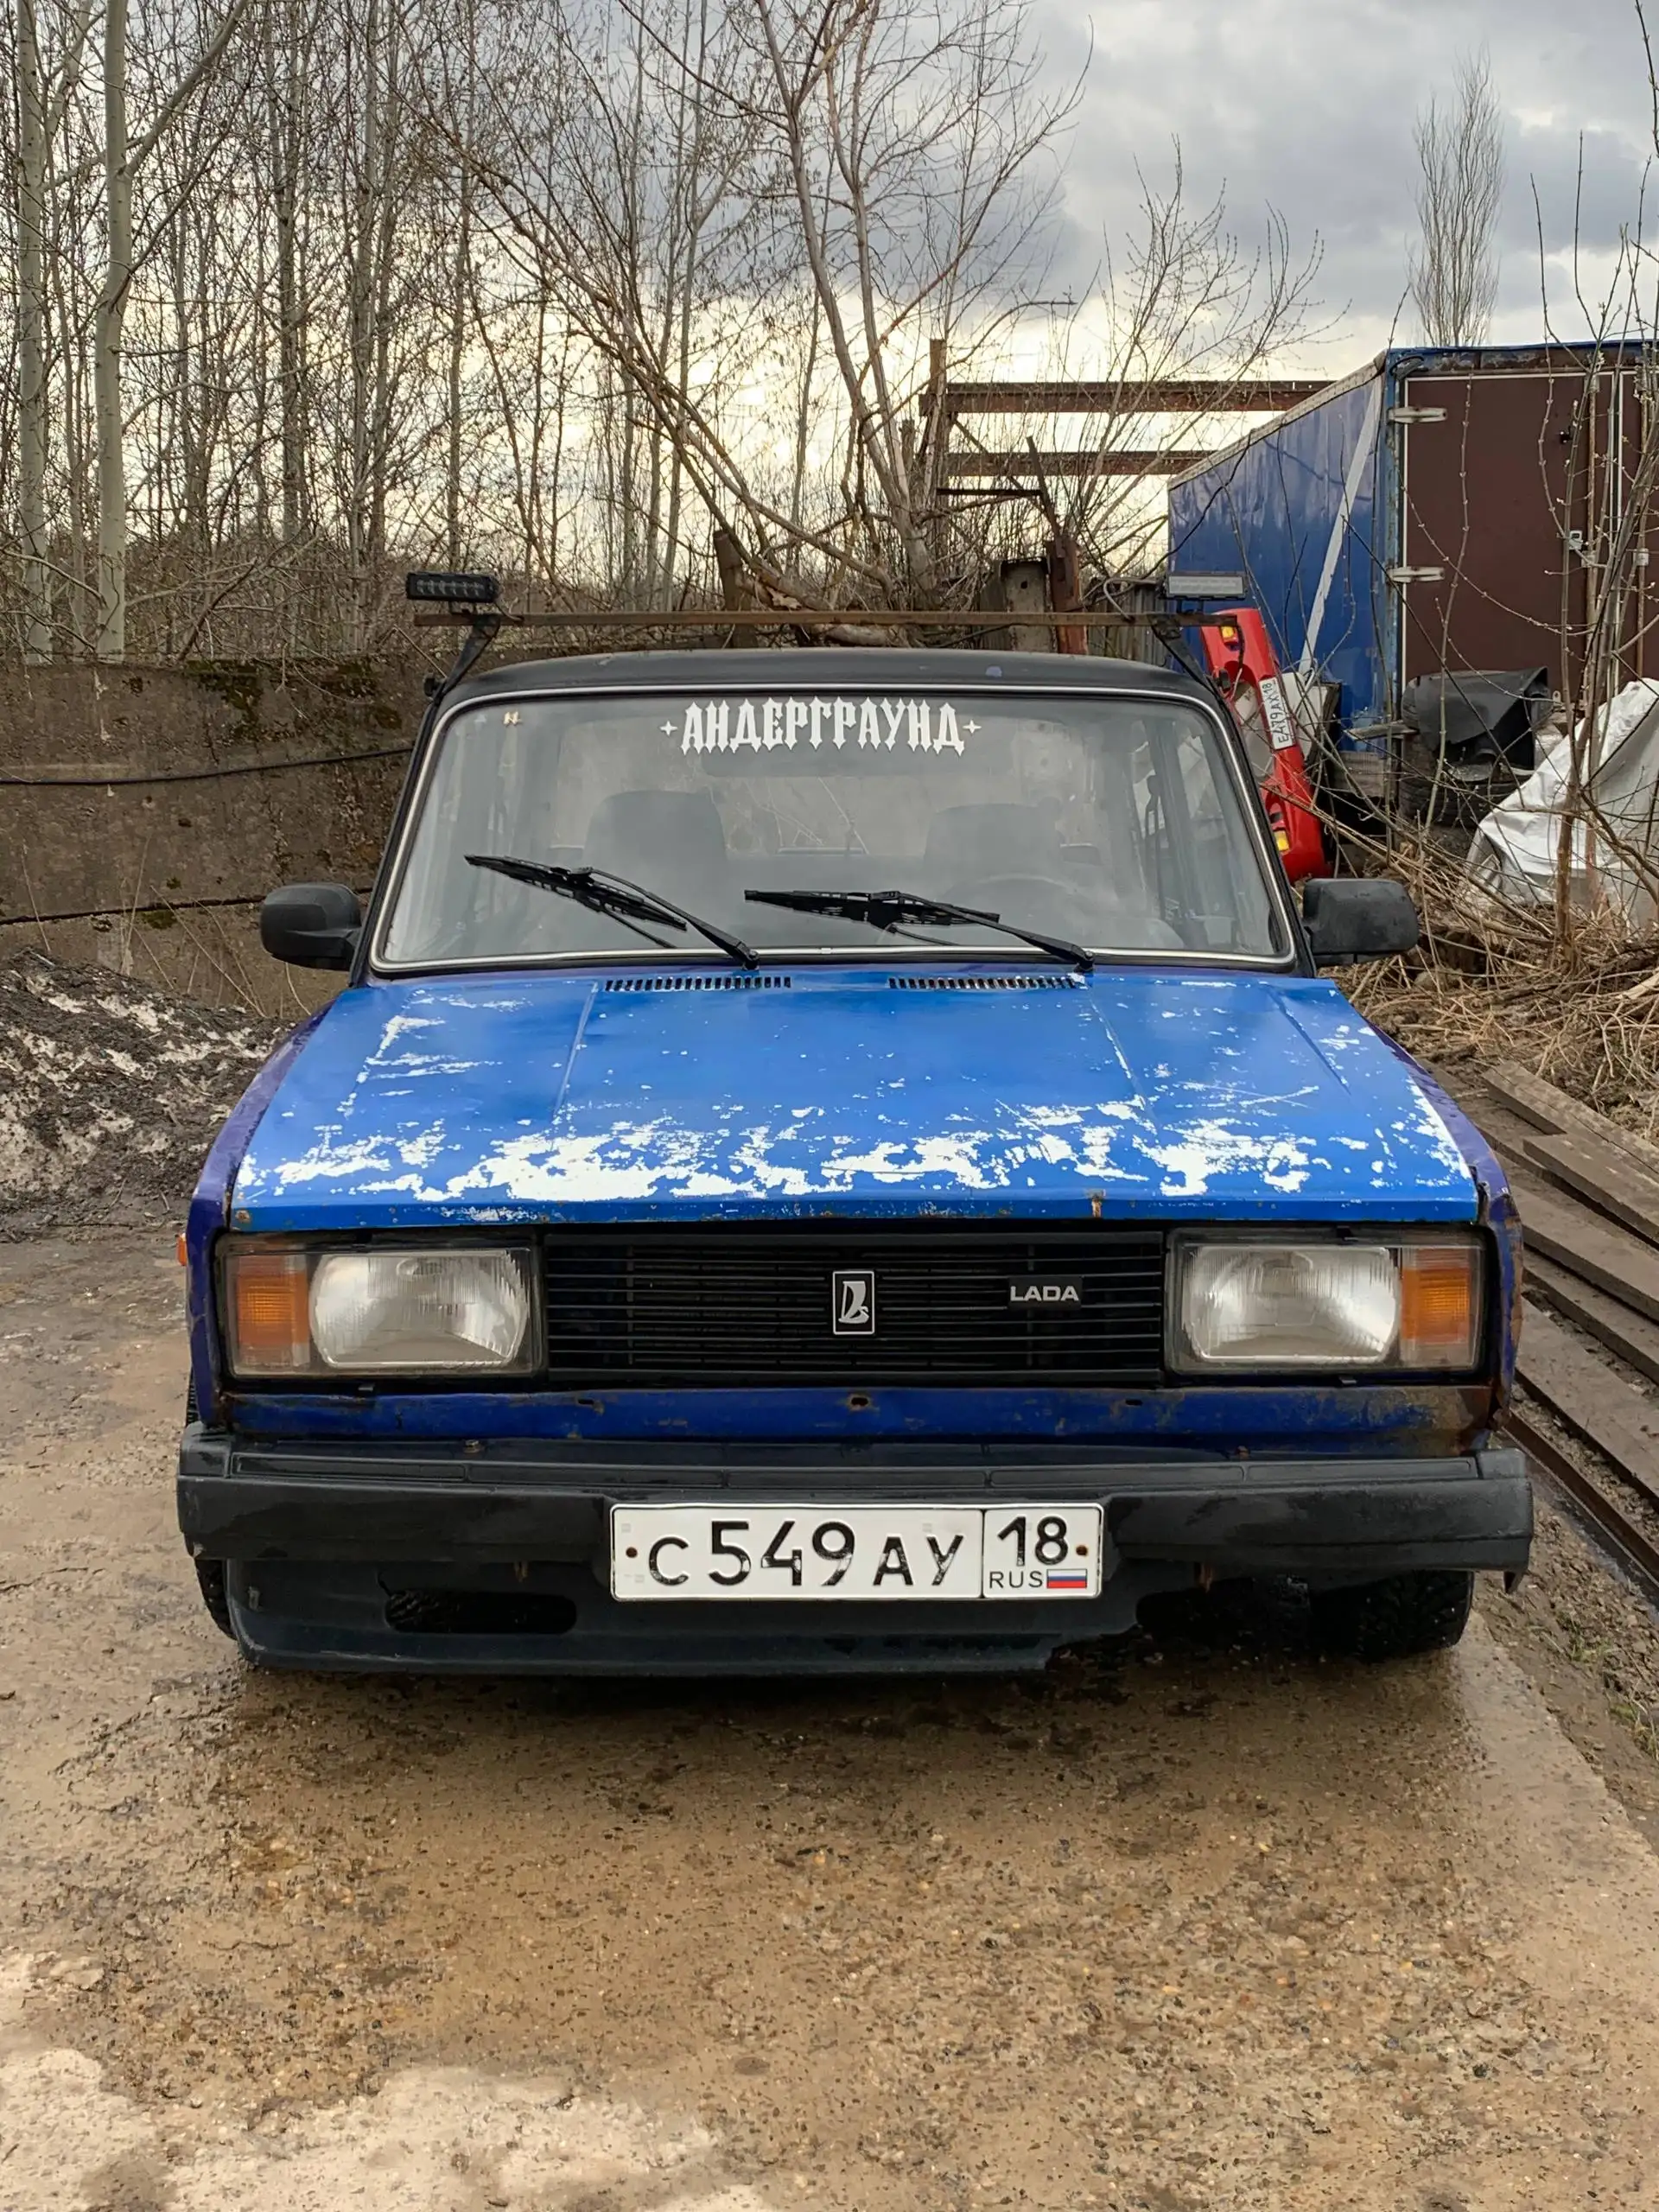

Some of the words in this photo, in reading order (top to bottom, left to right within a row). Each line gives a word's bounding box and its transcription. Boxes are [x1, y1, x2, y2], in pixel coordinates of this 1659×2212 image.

[681, 696, 964, 756] АНДЕРГРАУНД
[1009, 1285, 1079, 1301] LADA
[997, 1516, 1069, 1567] 18
[989, 1570, 1043, 1589] RUS
